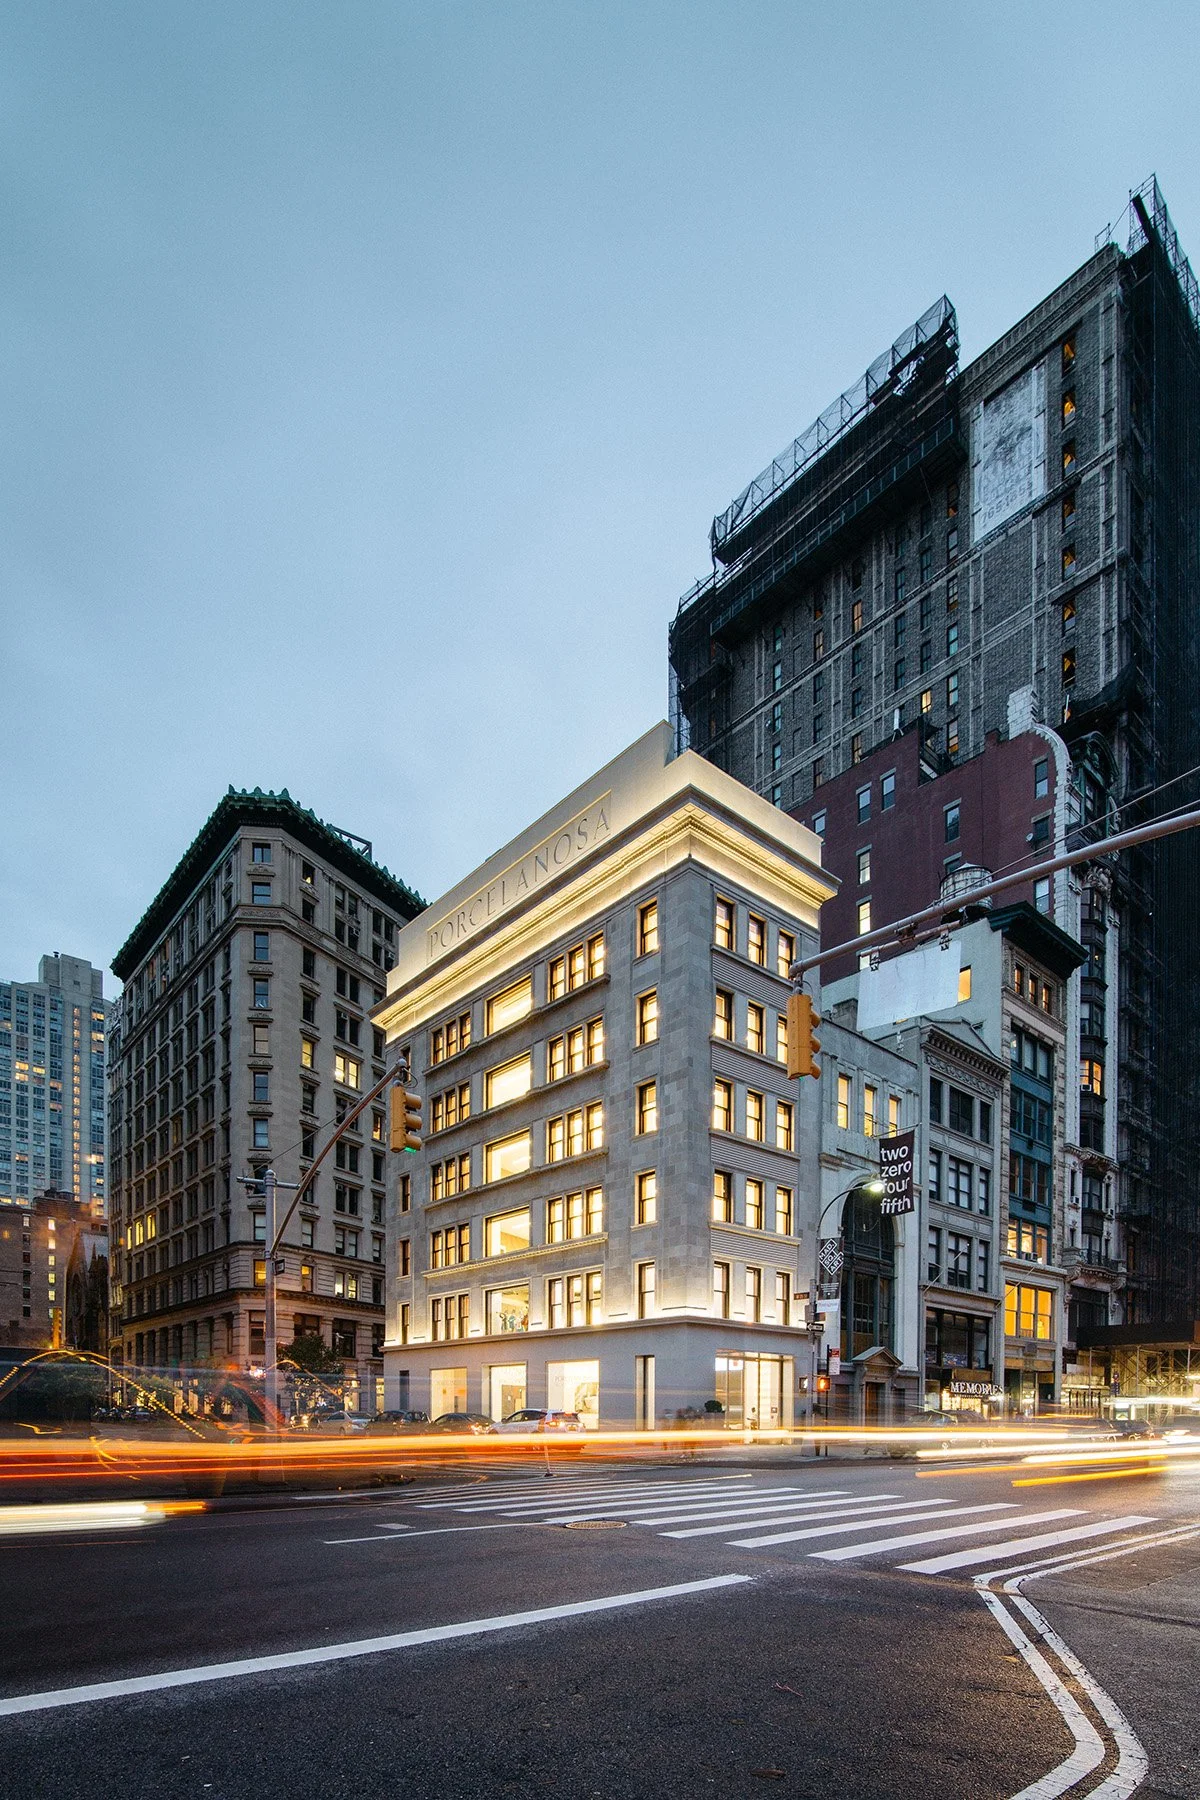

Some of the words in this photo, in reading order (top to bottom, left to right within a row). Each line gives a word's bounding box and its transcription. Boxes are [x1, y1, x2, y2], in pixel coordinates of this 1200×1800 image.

[430, 808, 610, 957] PORCELANOSA
[881, 1146, 909, 1162] two
[881, 1161, 912, 1178] zero
[882, 1177, 911, 1194] four
[880, 1195, 911, 1214] fifth
[950, 1381, 1005, 1396] MEMORIES
